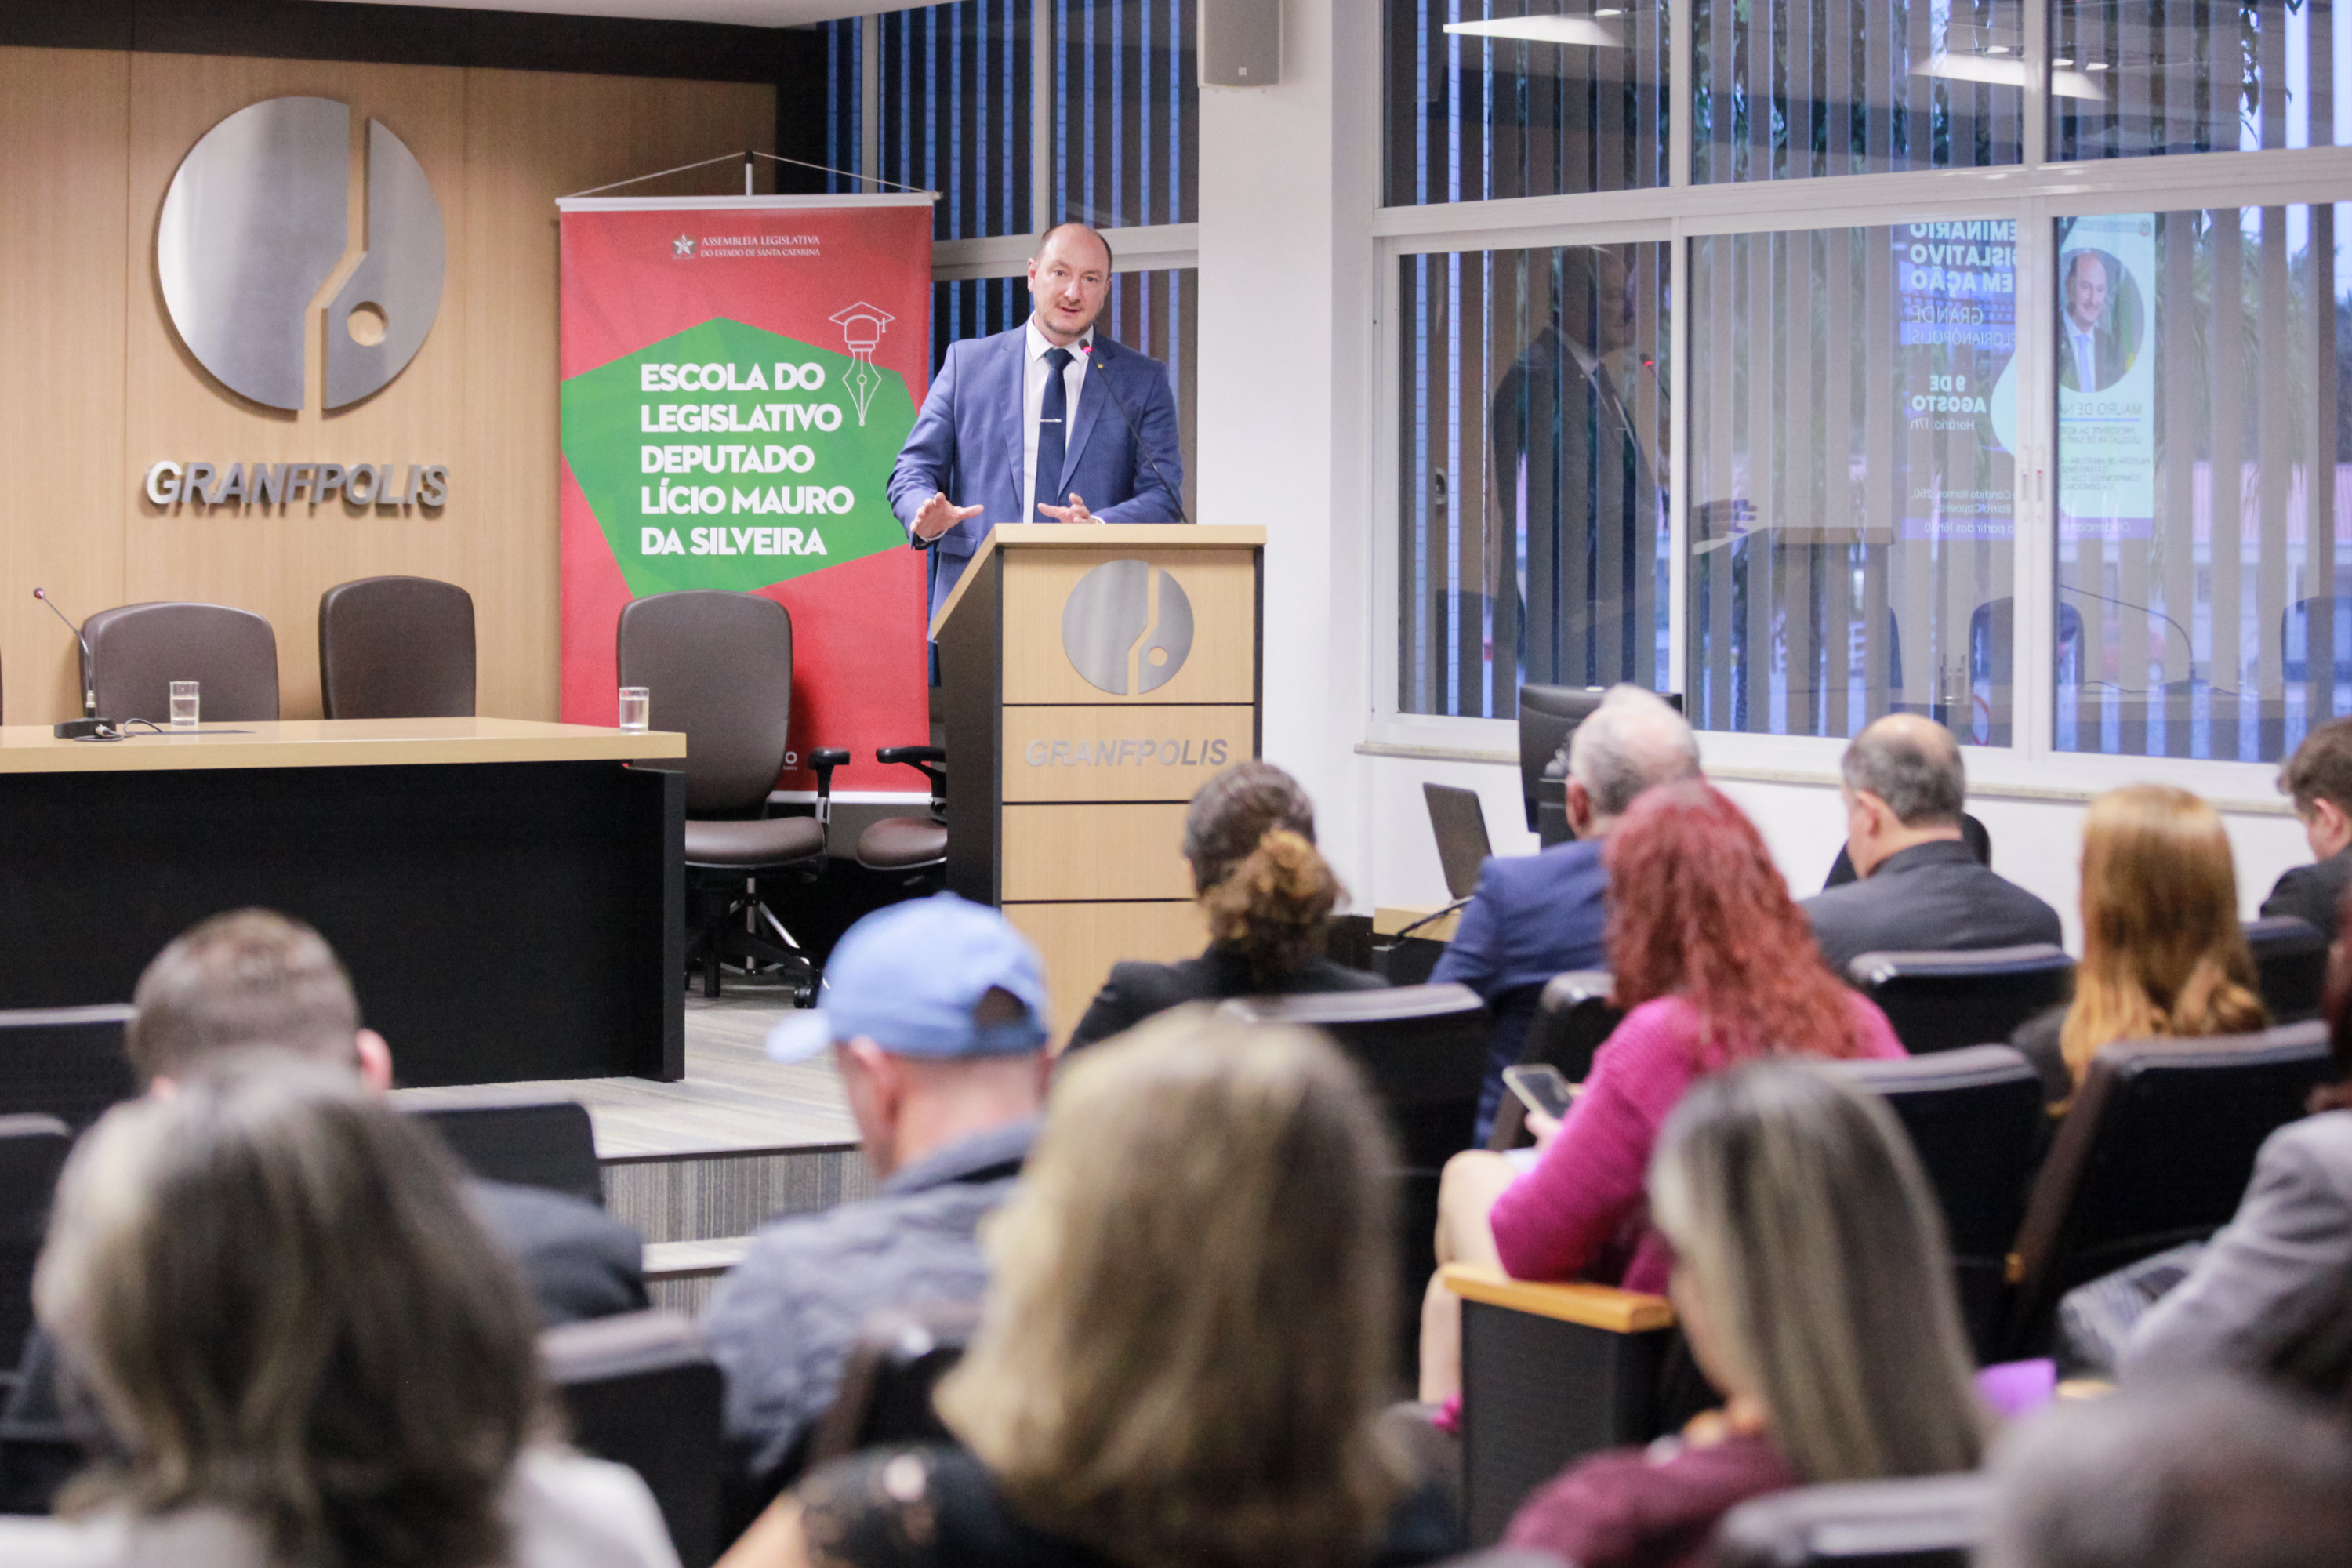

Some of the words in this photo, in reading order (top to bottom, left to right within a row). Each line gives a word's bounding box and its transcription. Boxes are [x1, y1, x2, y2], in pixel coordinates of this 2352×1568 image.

[702, 236, 759, 246] ASSEMBLEIA
[760, 235, 820, 245] LEGISLATIVA
[715, 249, 744, 257] ESTADO
[782, 248, 821, 256] CATARINA
[641, 362, 769, 391] ESCOLA
[775, 362, 826, 390] DO
[641, 403, 843, 432] LEGISLATIVO
[641, 445, 815, 474] DEPUTADO
[146, 460, 450, 506] GRANFPOLIS
[641, 477, 727, 514] LÍCIO
[731, 485, 855, 514] MAURO
[641, 527, 686, 555] DA
[690, 527, 828, 555] SILVEIRA
[1025, 739, 1228, 767] GRANFPOLIS
